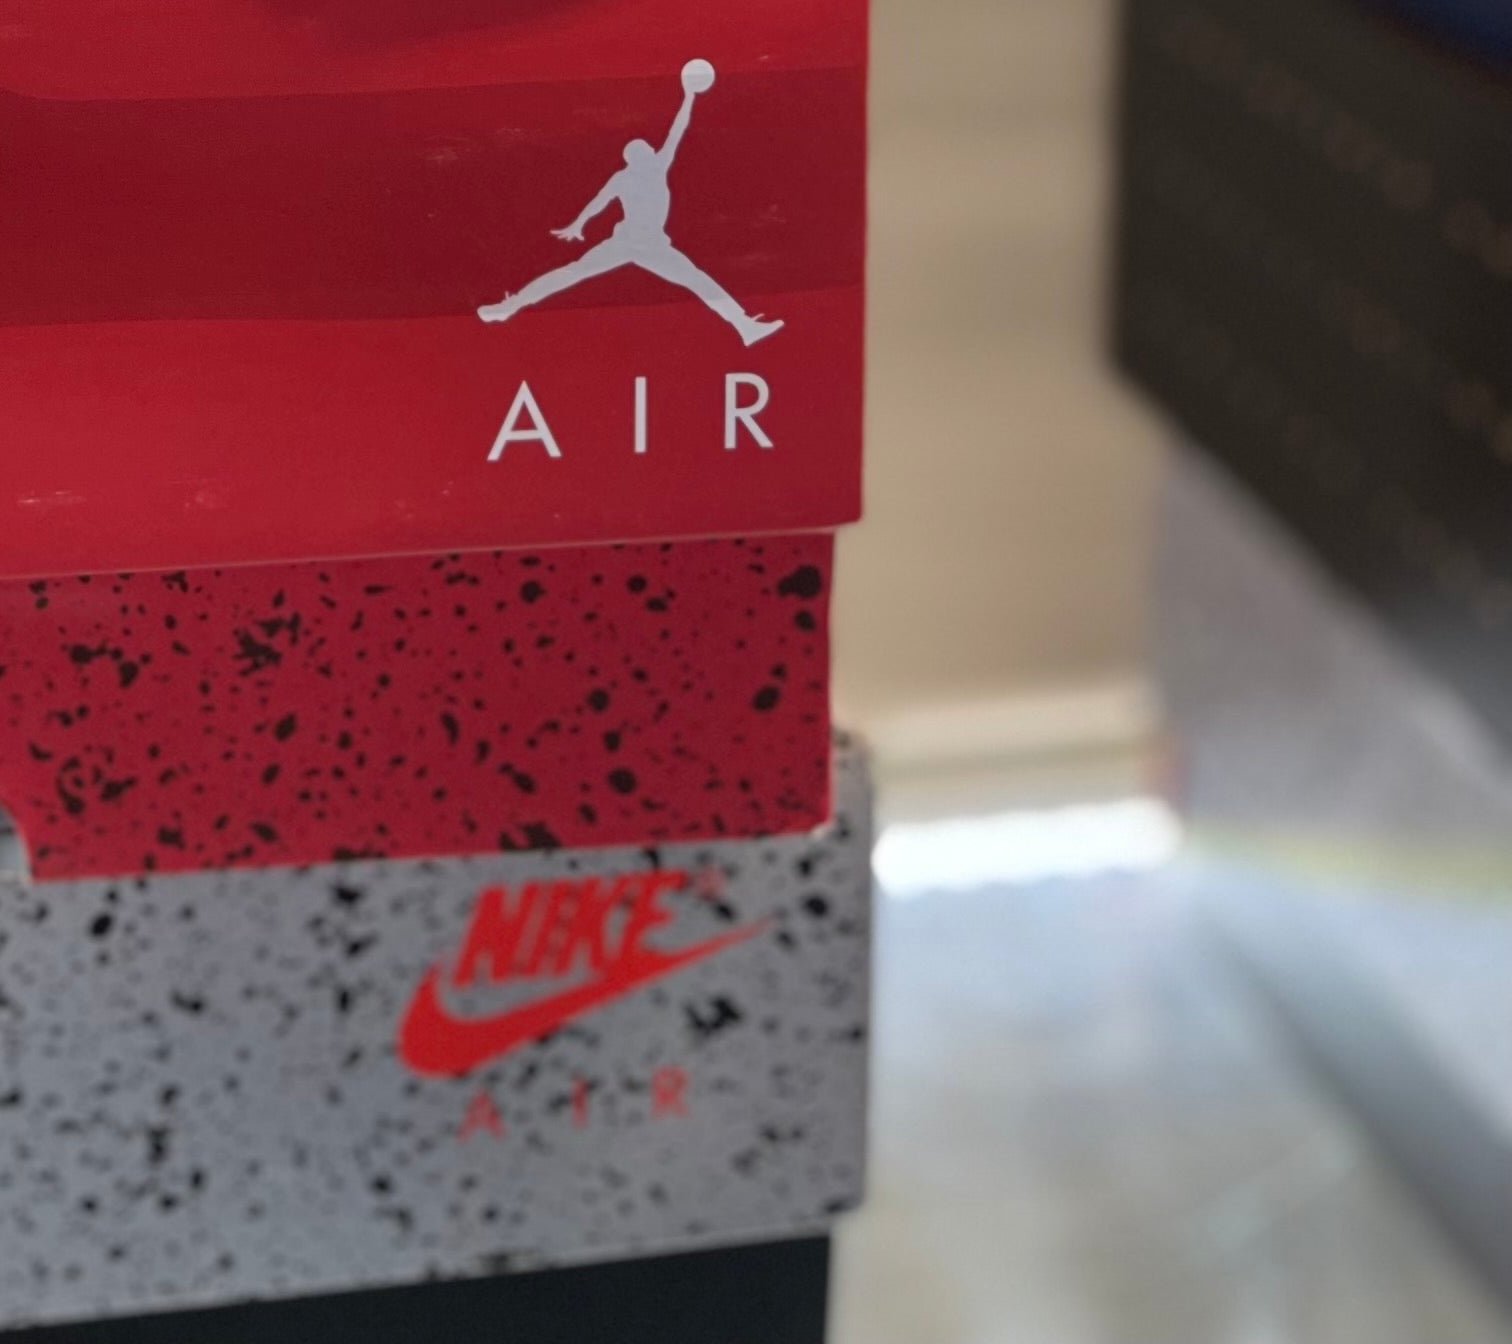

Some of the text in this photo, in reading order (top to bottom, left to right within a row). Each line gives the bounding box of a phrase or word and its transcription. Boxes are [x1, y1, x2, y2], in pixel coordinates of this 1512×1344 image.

[488, 372, 774, 461] AIR
[451, 869, 691, 989] NIKE
[457, 1065, 689, 1142] AIR
